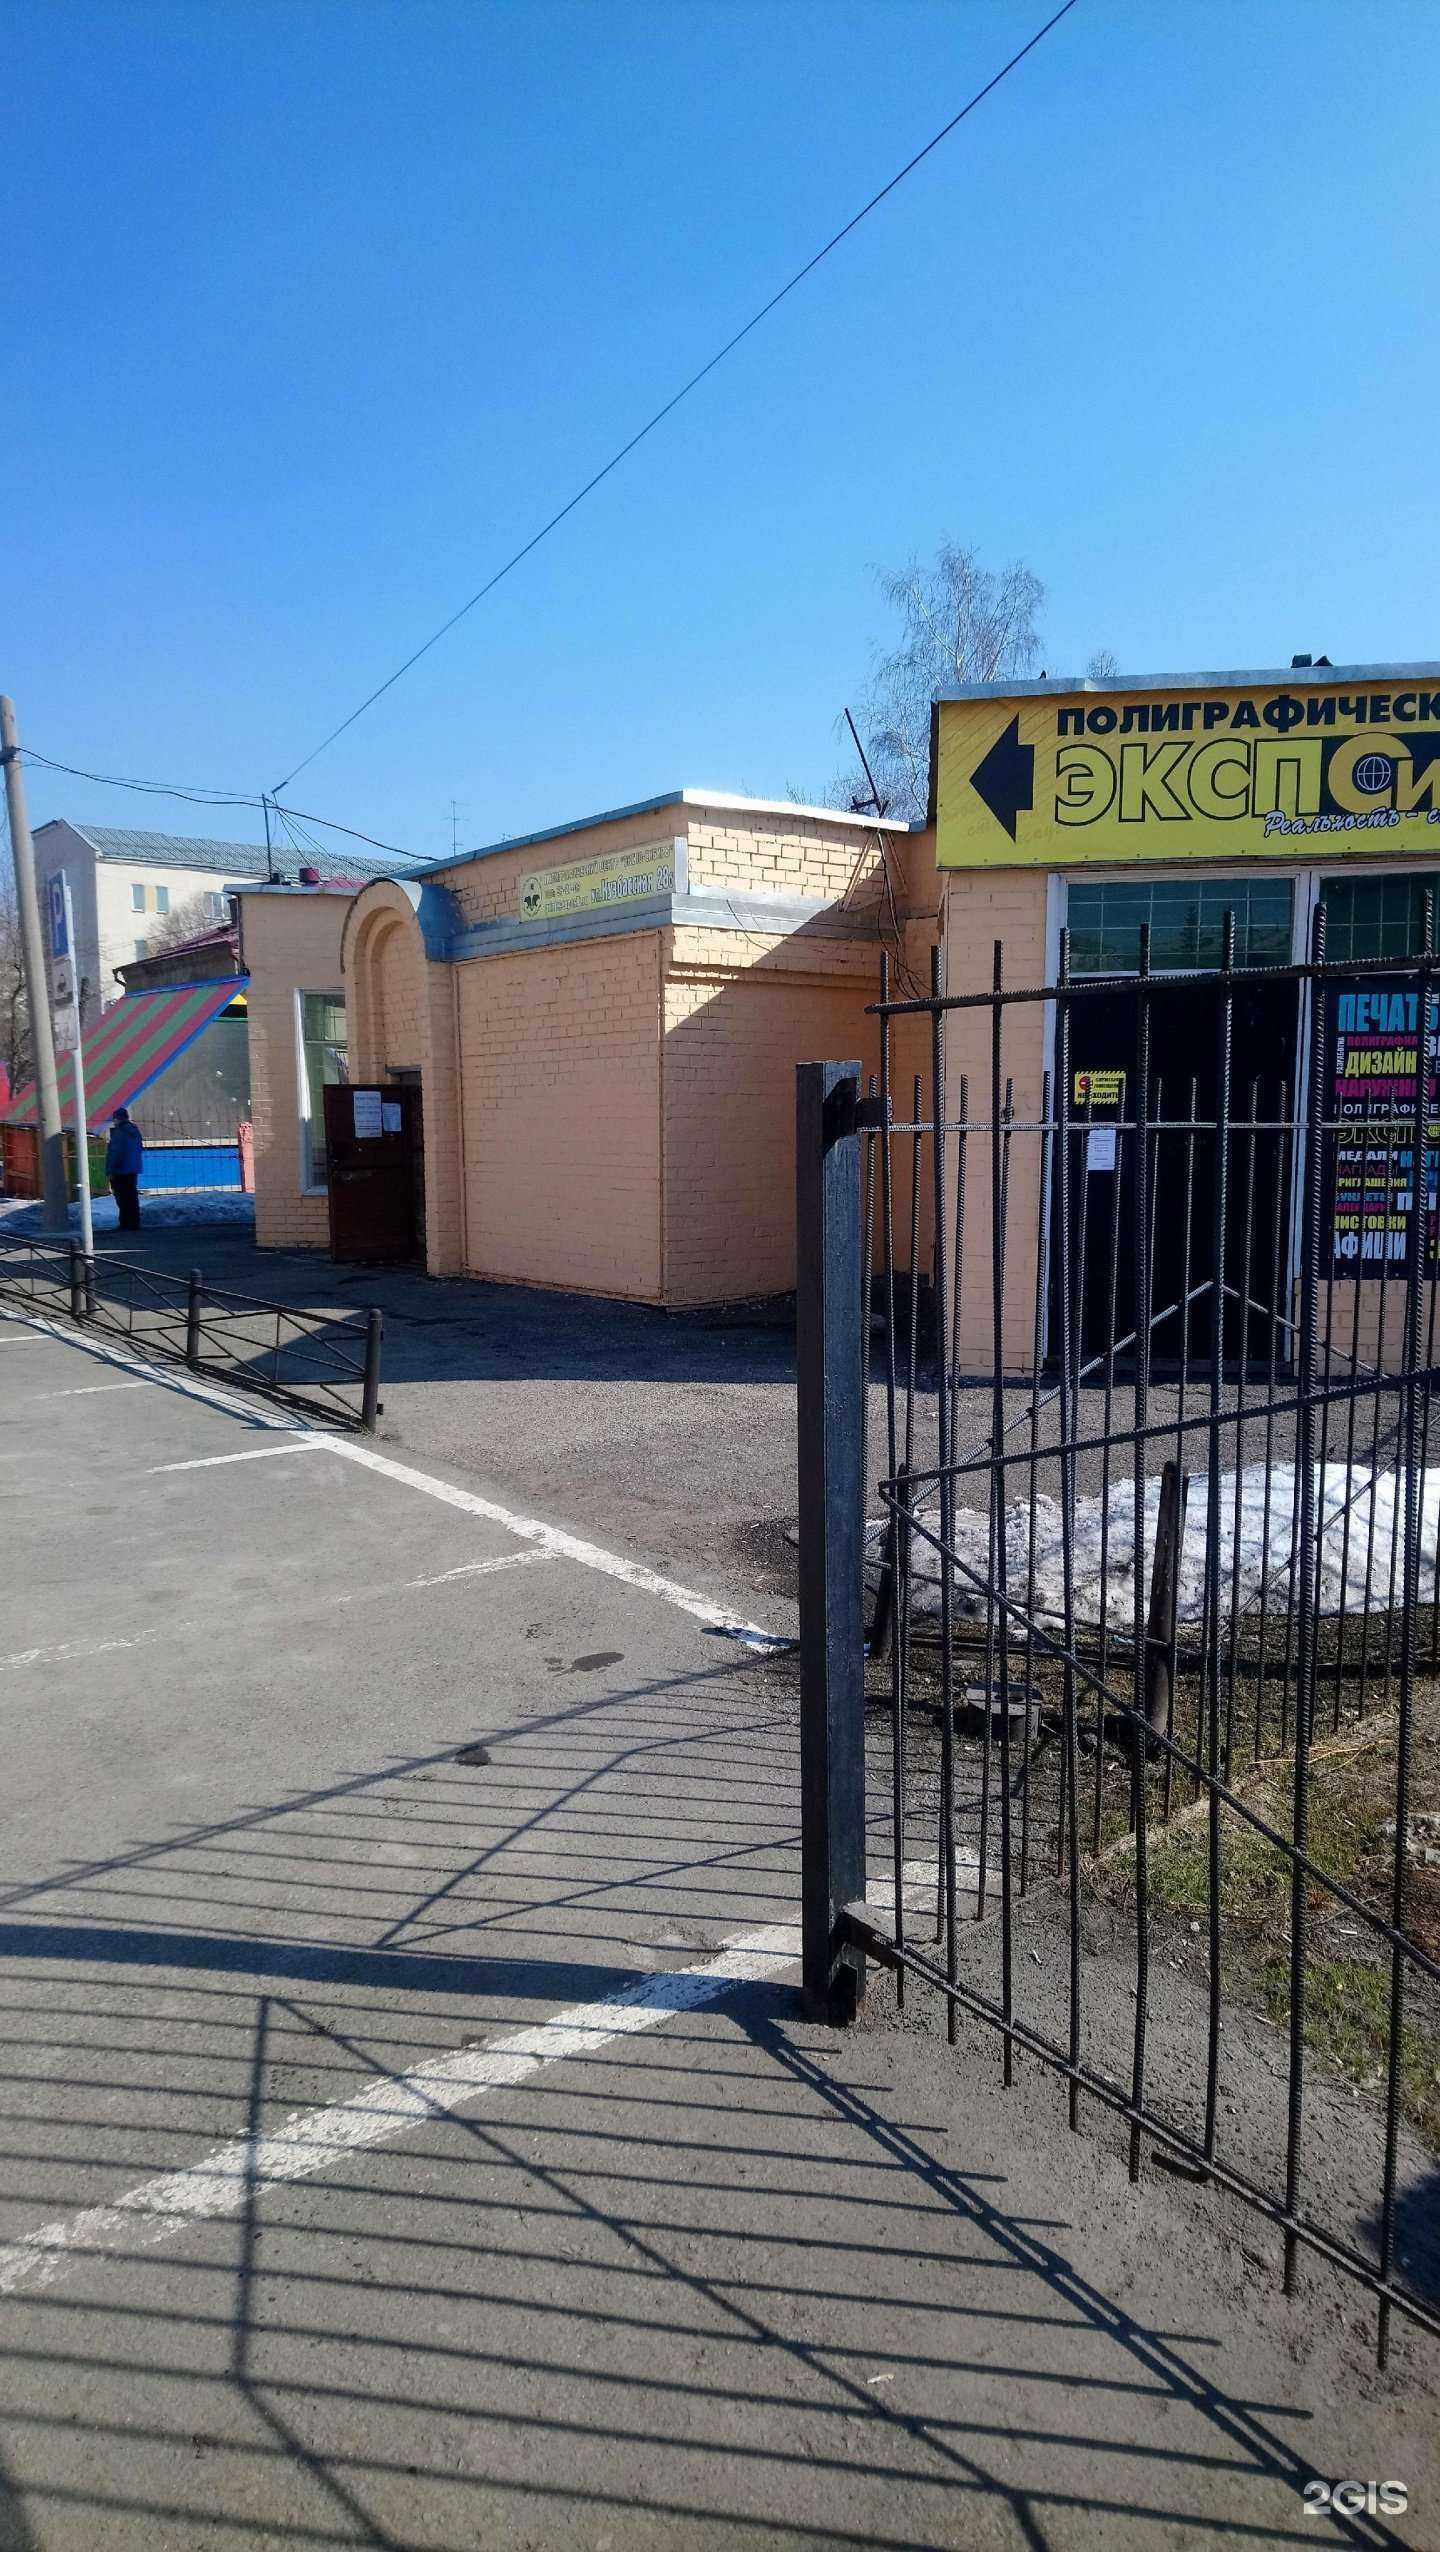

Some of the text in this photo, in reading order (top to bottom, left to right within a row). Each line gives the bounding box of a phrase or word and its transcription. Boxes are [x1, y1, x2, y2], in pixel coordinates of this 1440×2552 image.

[1057, 693, 1440, 736] ПОЛИГРАФИЧЕСК
[1264, 805, 1400, 838] Реальность
[1345, 1046, 1417, 1077] ДИЗАЙН
